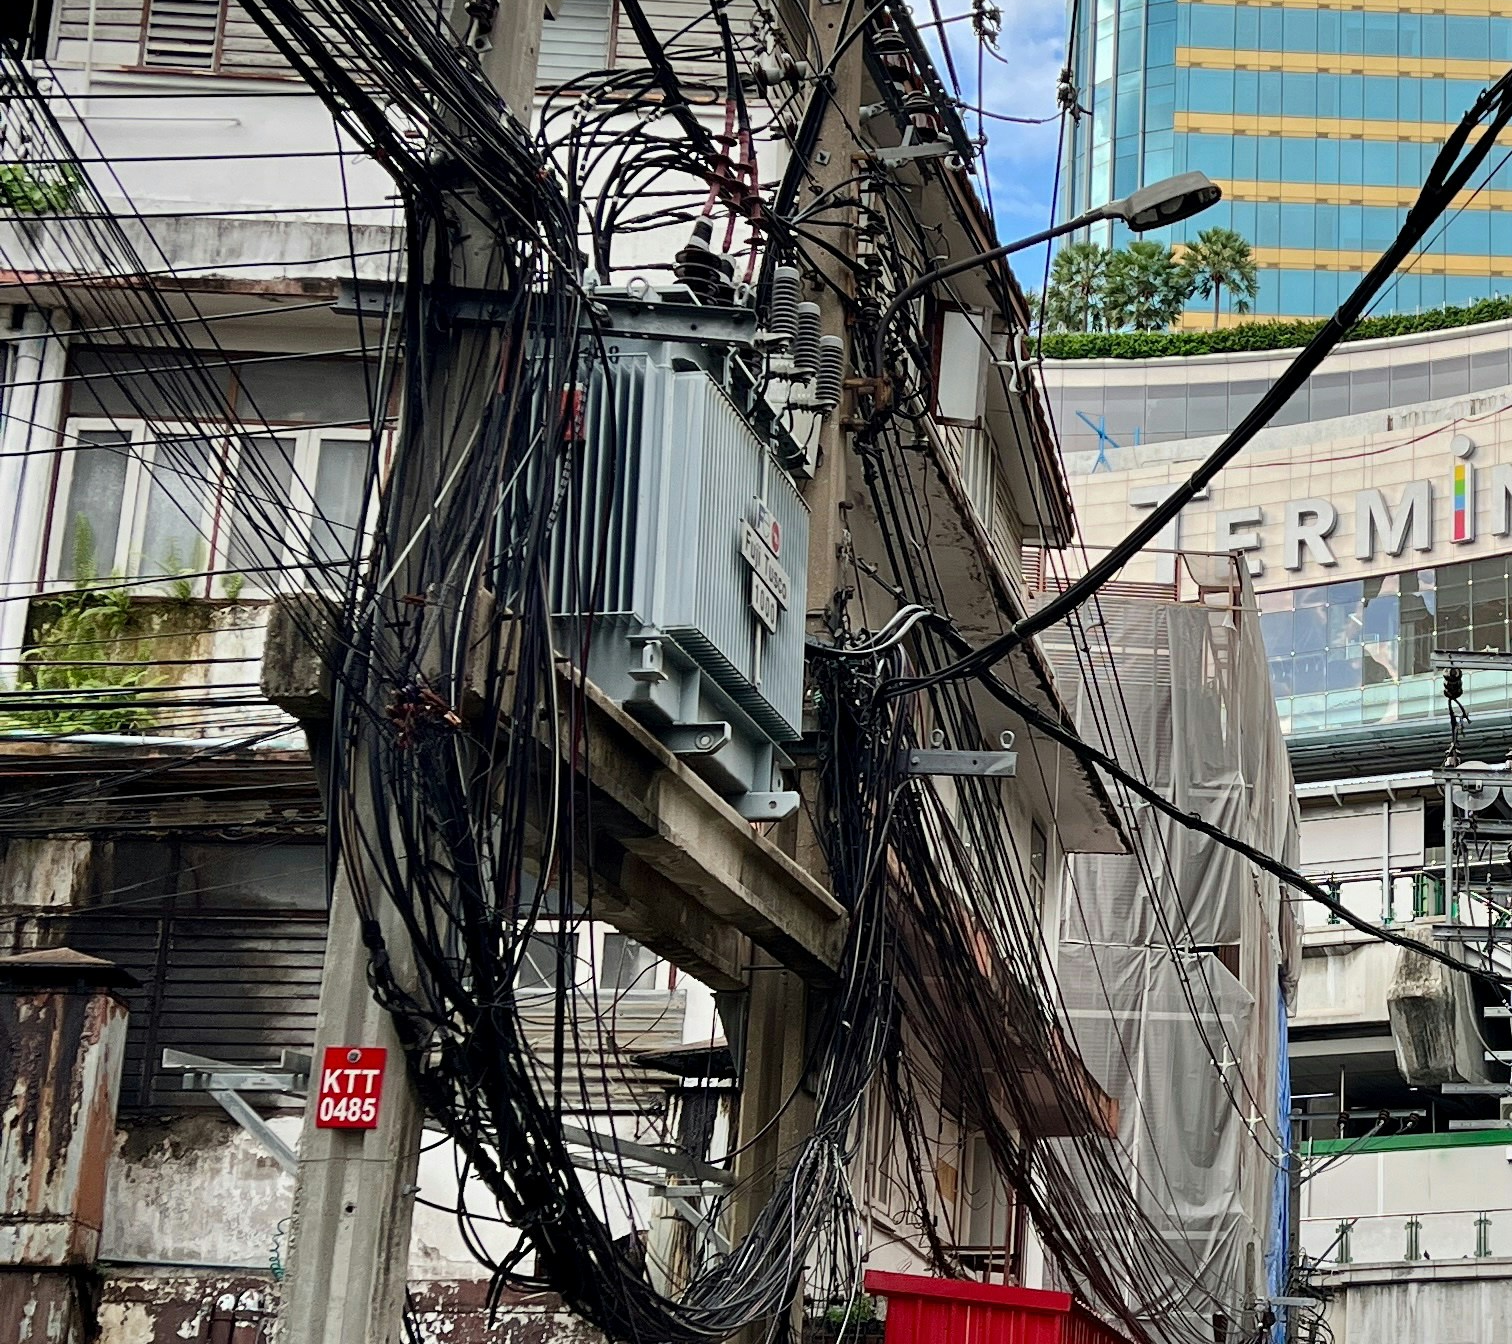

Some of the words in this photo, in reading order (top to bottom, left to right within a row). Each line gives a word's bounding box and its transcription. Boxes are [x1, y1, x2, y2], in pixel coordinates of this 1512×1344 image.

[744, 529, 762, 570] Fuji
[764, 553, 787, 601] Tusco
[755, 582, 776, 625] 1000
[322, 1068, 381, 1094] KTT
[319, 1097, 377, 1123] 0485
